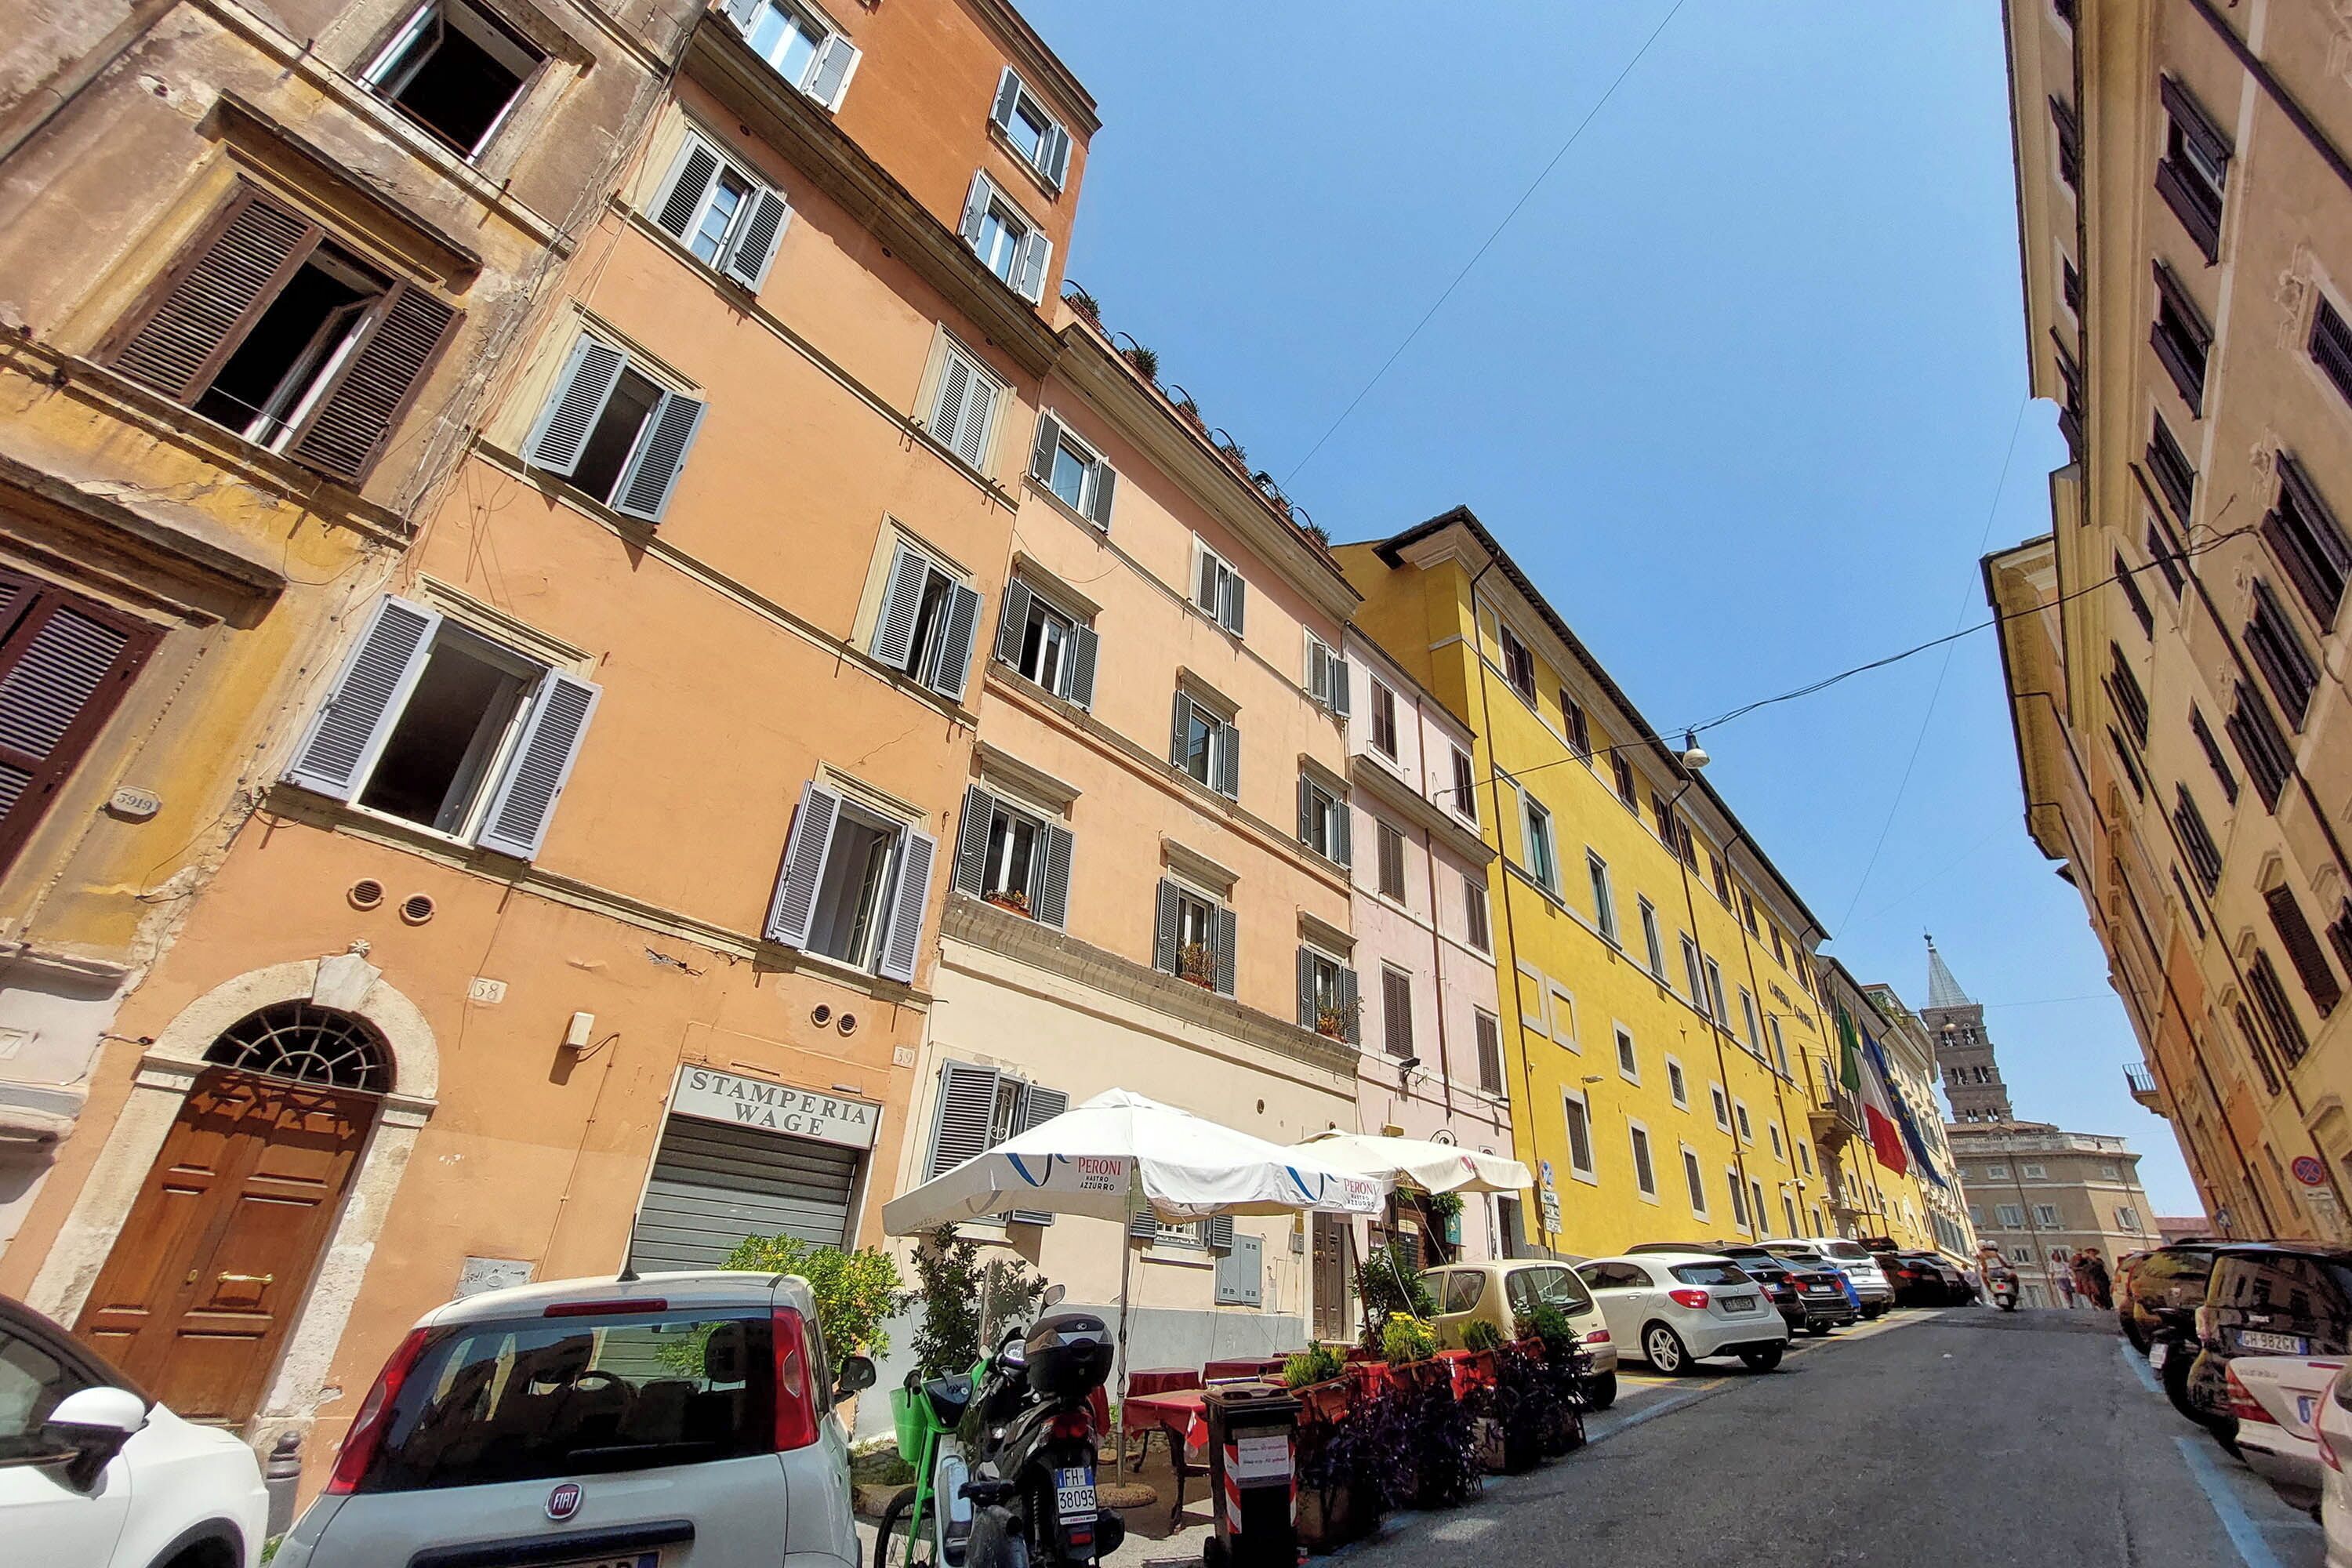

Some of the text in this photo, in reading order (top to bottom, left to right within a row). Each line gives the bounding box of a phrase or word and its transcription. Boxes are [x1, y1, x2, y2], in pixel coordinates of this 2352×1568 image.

[690, 1071, 866, 1124] STAMPERIA
[735, 1102, 824, 1137] WAGE
[1078, 1156, 1121, 1175] PERONI
[1080, 1181, 1115, 1191] AZZURRO
[1343, 1178, 1377, 1196] PERONI
[1064, 1468, 1079, 1486] FH
[553, 1491, 578, 1510] FIAT
[1058, 1490, 1095, 1509] 38093
